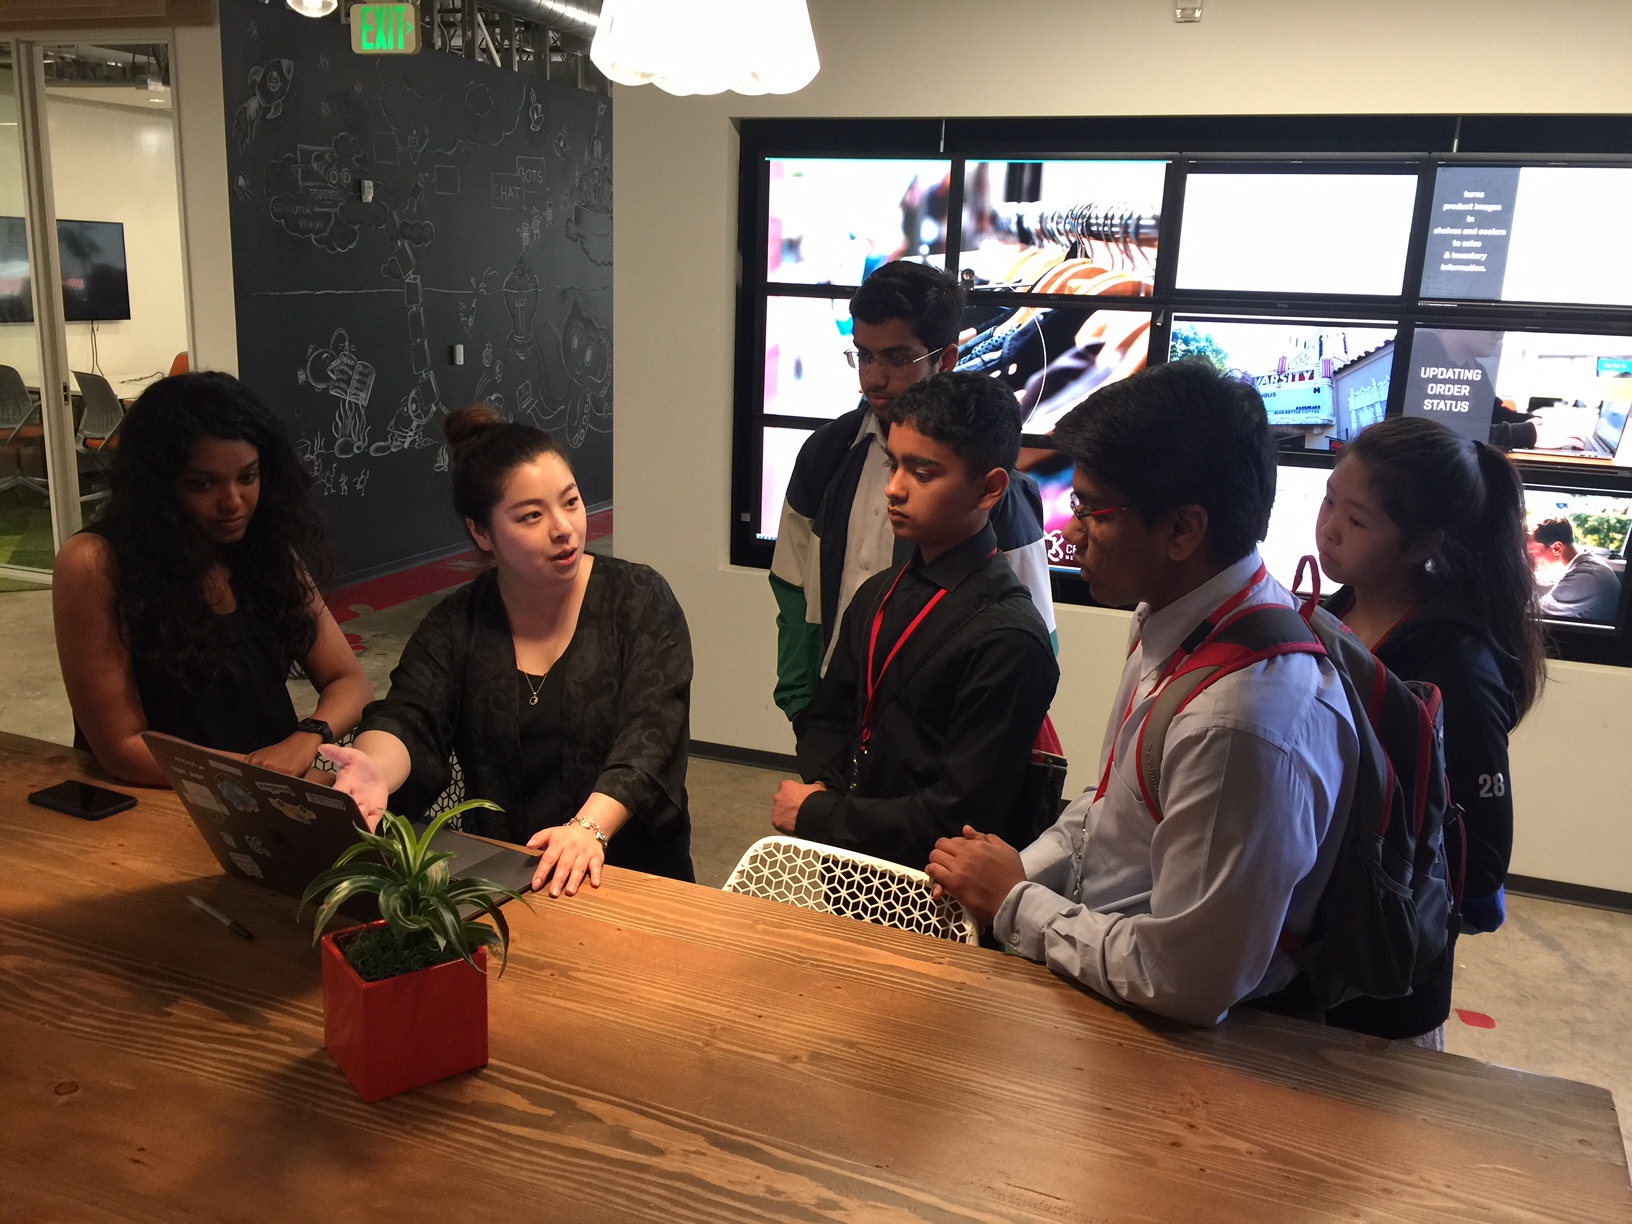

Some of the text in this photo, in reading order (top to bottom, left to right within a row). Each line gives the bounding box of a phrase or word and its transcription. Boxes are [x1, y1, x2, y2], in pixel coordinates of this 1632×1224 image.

[361, 5, 406, 50] EXIT
[494, 183, 521, 201] CHAT
[1463, 190, 1485, 198] turns
[1443, 202, 1502, 212] product images
[1462, 227, 1478, 235] and
[1452, 239, 1461, 247] to
[1451, 251, 1488, 261] inventory
[1256, 370, 1313, 386] VARSITY
[1420, 366, 1483, 381] UPDATING
[1427, 383, 1471, 396] ORDER
[1423, 399, 1470, 413] STATUS
[1478, 772, 1506, 798] 28
